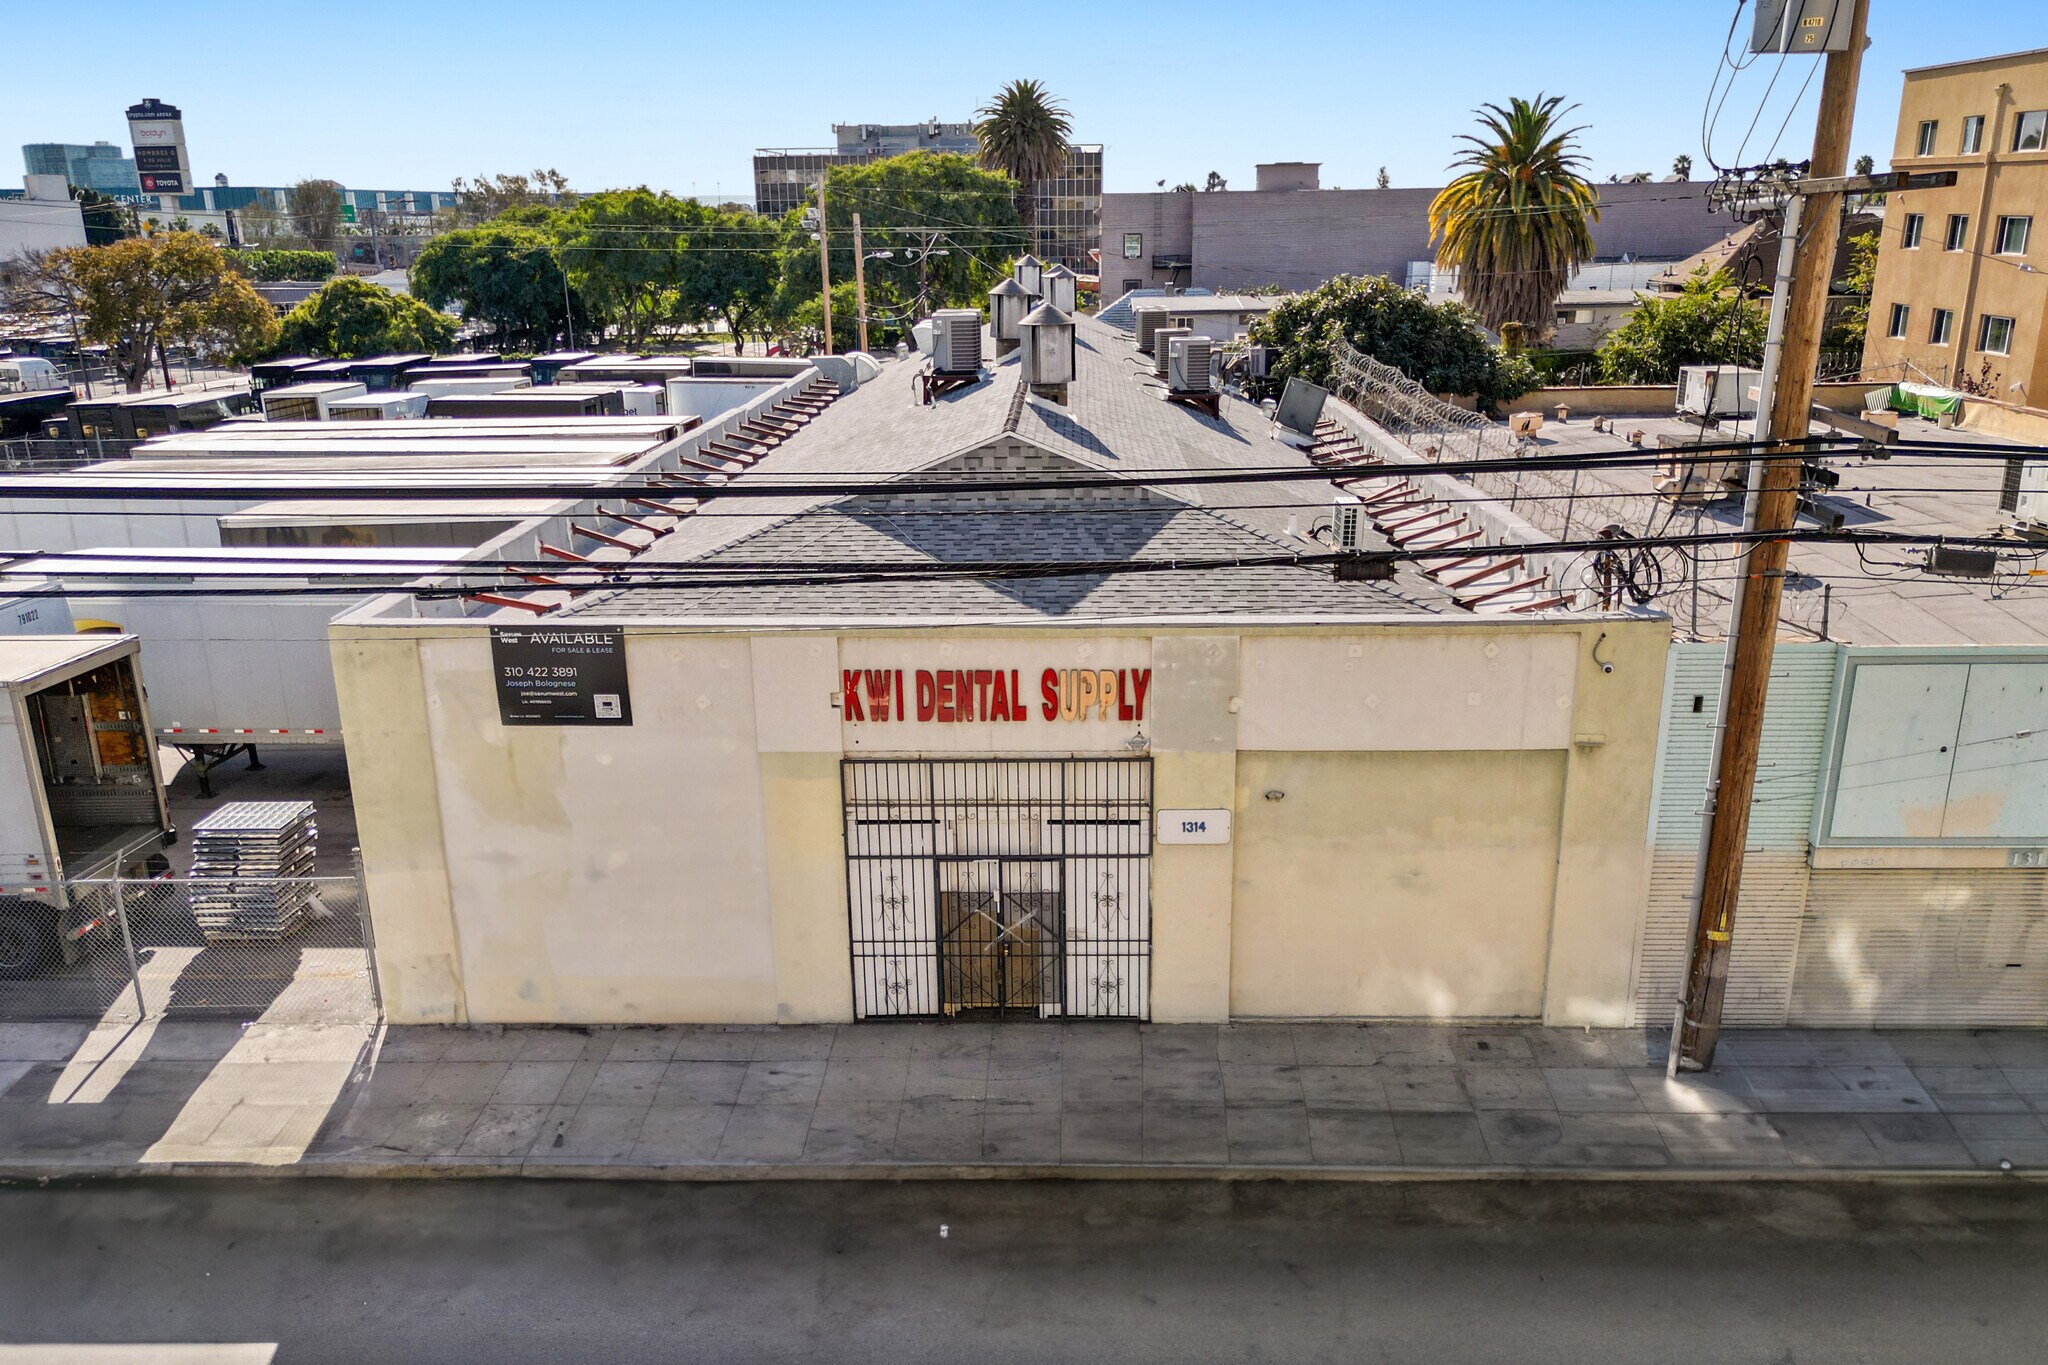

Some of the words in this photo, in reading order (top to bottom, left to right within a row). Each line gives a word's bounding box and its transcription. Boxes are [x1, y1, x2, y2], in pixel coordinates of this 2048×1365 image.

[113, 195, 152, 204] CENTER
[18, 609, 39, 626] 791022
[530, 632, 613, 645] AVAILABLE
[504, 667, 523, 677] 310
[527, 667, 548, 677] 422
[551, 667, 577, 677] 3891
[535, 680, 576, 688] Bolognese
[843, 669, 904, 722] KWI
[916, 669, 1027, 722] DENTAL
[1041, 668, 1152, 722] SUPPLY
[1181, 821, 1206, 832] 1314
